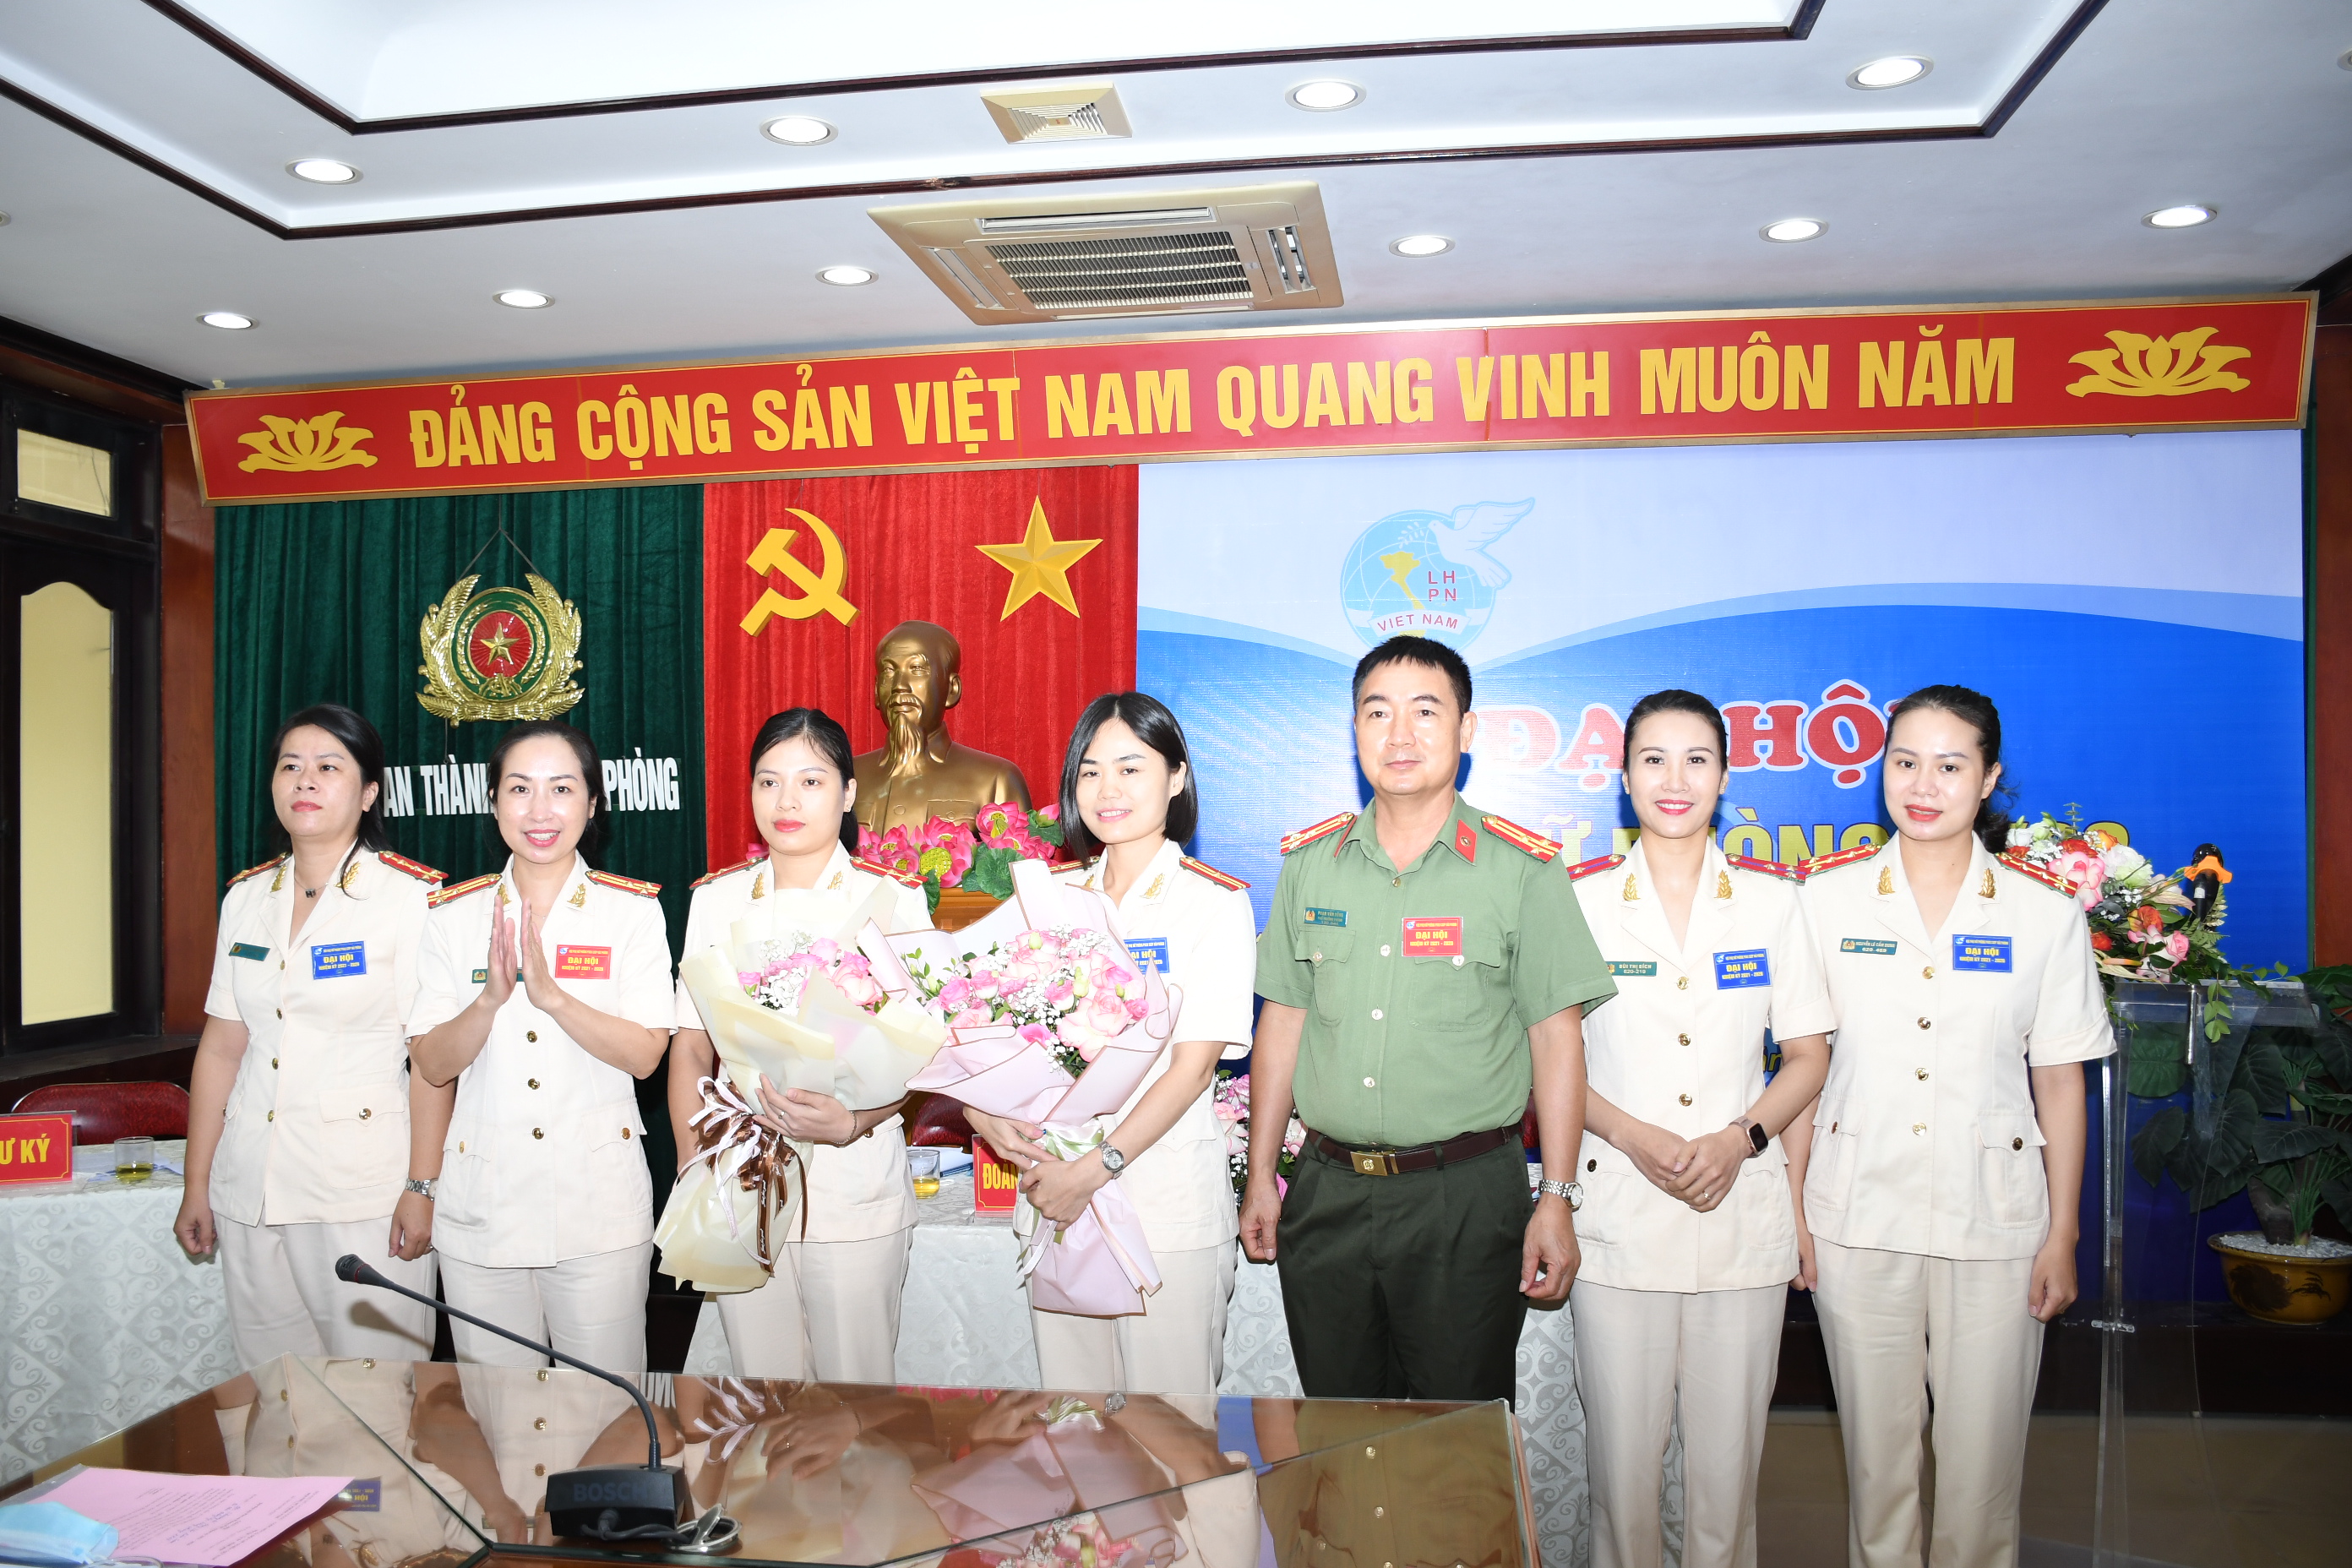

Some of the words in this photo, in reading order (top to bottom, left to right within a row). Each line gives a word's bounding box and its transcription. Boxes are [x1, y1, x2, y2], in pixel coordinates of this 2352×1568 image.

[411, 384, 555, 468] ĐẢNG
[578, 385, 732, 470] CỘNG
[753, 364, 873, 451] SẢN
[895, 366, 1020, 454] VIỆT
[1045, 369, 1191, 438] NAM
[1217, 357, 1434, 437] QUANG
[1456, 351, 1609, 422] VINH
[1640, 331, 1829, 414] MUÔN
[1859, 324, 2015, 408] NĂM
[1428, 570, 1456, 585] LH
[1428, 588, 1457, 602] PN
[1377, 614, 1414, 632] VIET
[1422, 613, 1459, 629] NAM
[1475, 704, 1625, 792] ĐẠ
[1719, 679, 1900, 789] HỘ
[384, 766, 415, 817] AN
[601, 747, 680, 812] PHÒNG
[1416, 931, 1430, 940] ĐẠI
[1433, 930, 1448, 939] HỘI
[324, 956, 338, 965] ĐẠI
[340, 953, 354, 962] HỘI
[1965, 947, 1981, 956] ĐẠI
[1984, 947, 2000, 956] HỘI
[568, 956, 583, 966] ĐẠI
[585, 956, 599, 966] HỘI
[1726, 964, 1740, 973] ĐẠI
[1742, 961, 1757, 971] HỘI
[0, 1137, 16, 1165] Ư
[20, 1133, 51, 1164] KÝ
[573, 1483, 648, 1503] BOSCH
